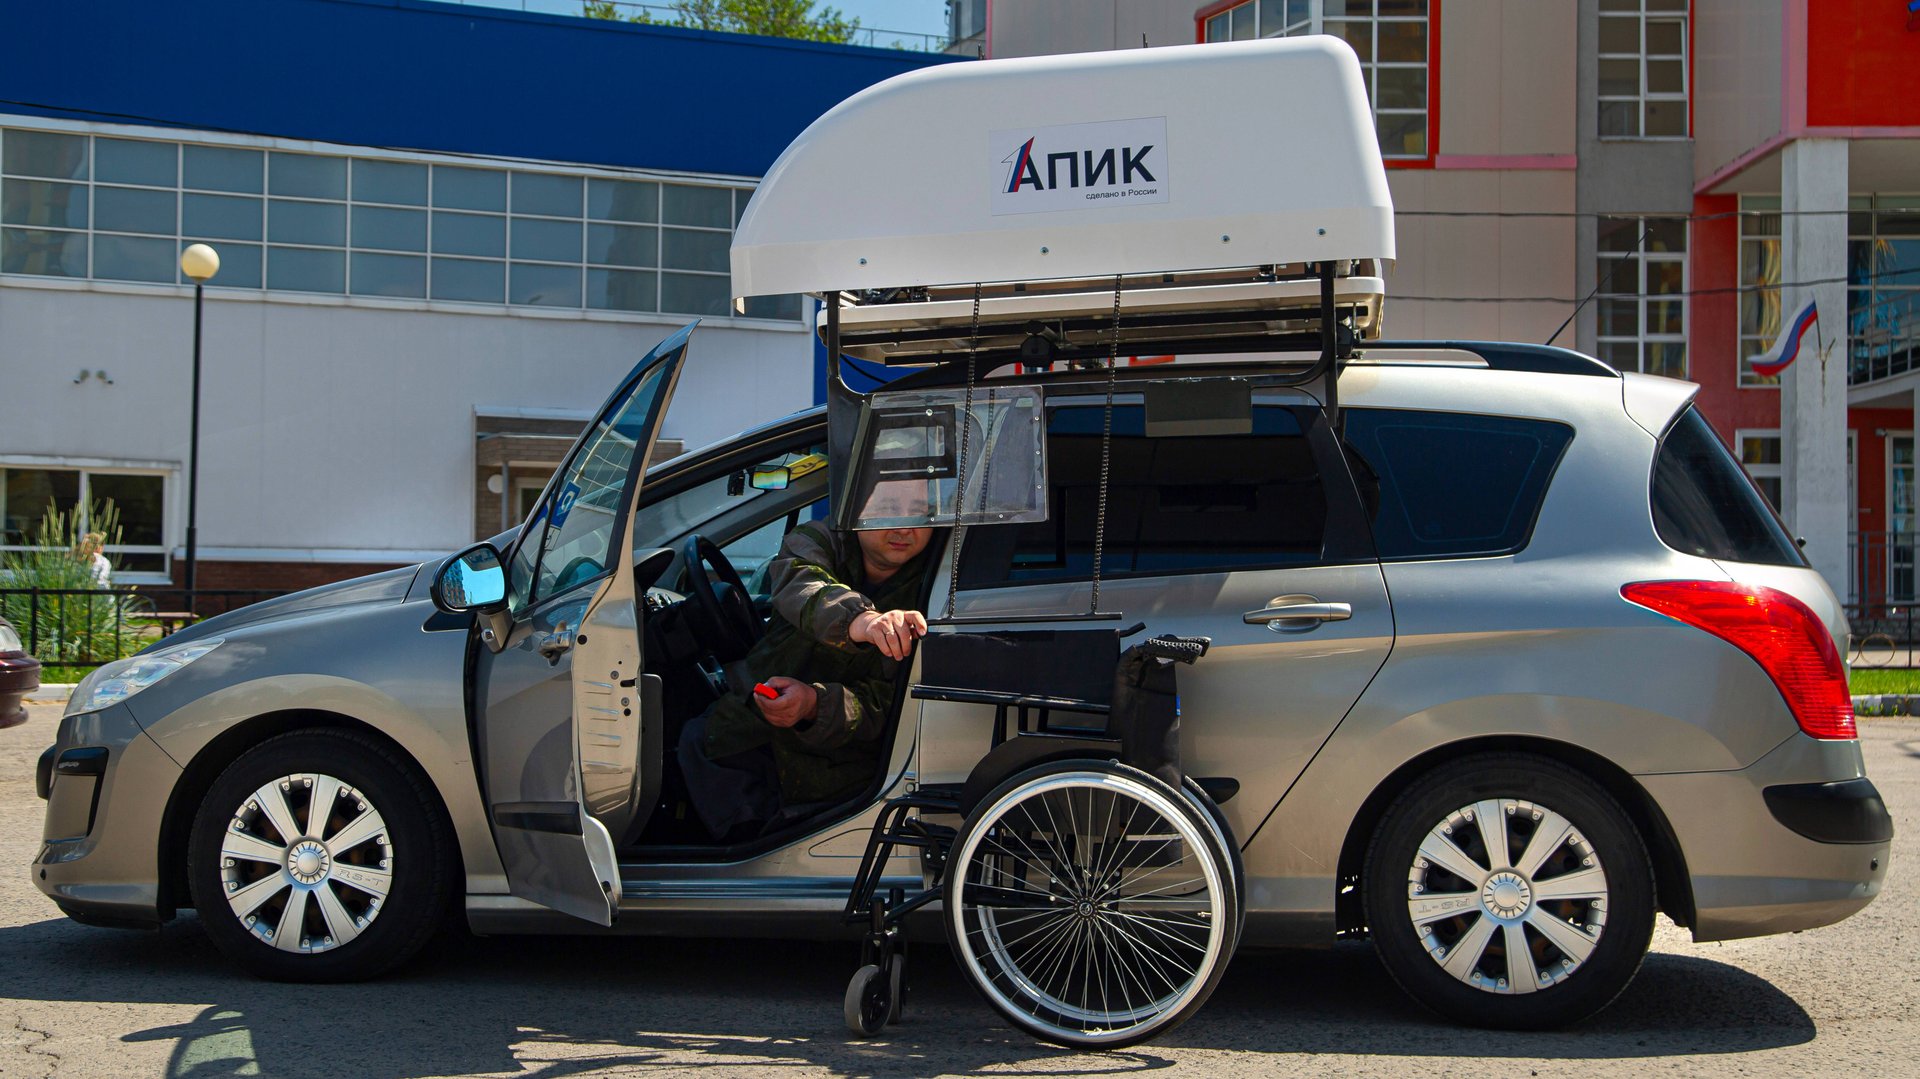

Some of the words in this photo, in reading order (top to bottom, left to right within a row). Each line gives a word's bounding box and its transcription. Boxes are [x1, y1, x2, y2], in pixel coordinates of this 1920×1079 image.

[1001, 136, 1156, 193] АПИК
[1085, 191, 1120, 200] сделано
[1128, 188, 1157, 196] России
